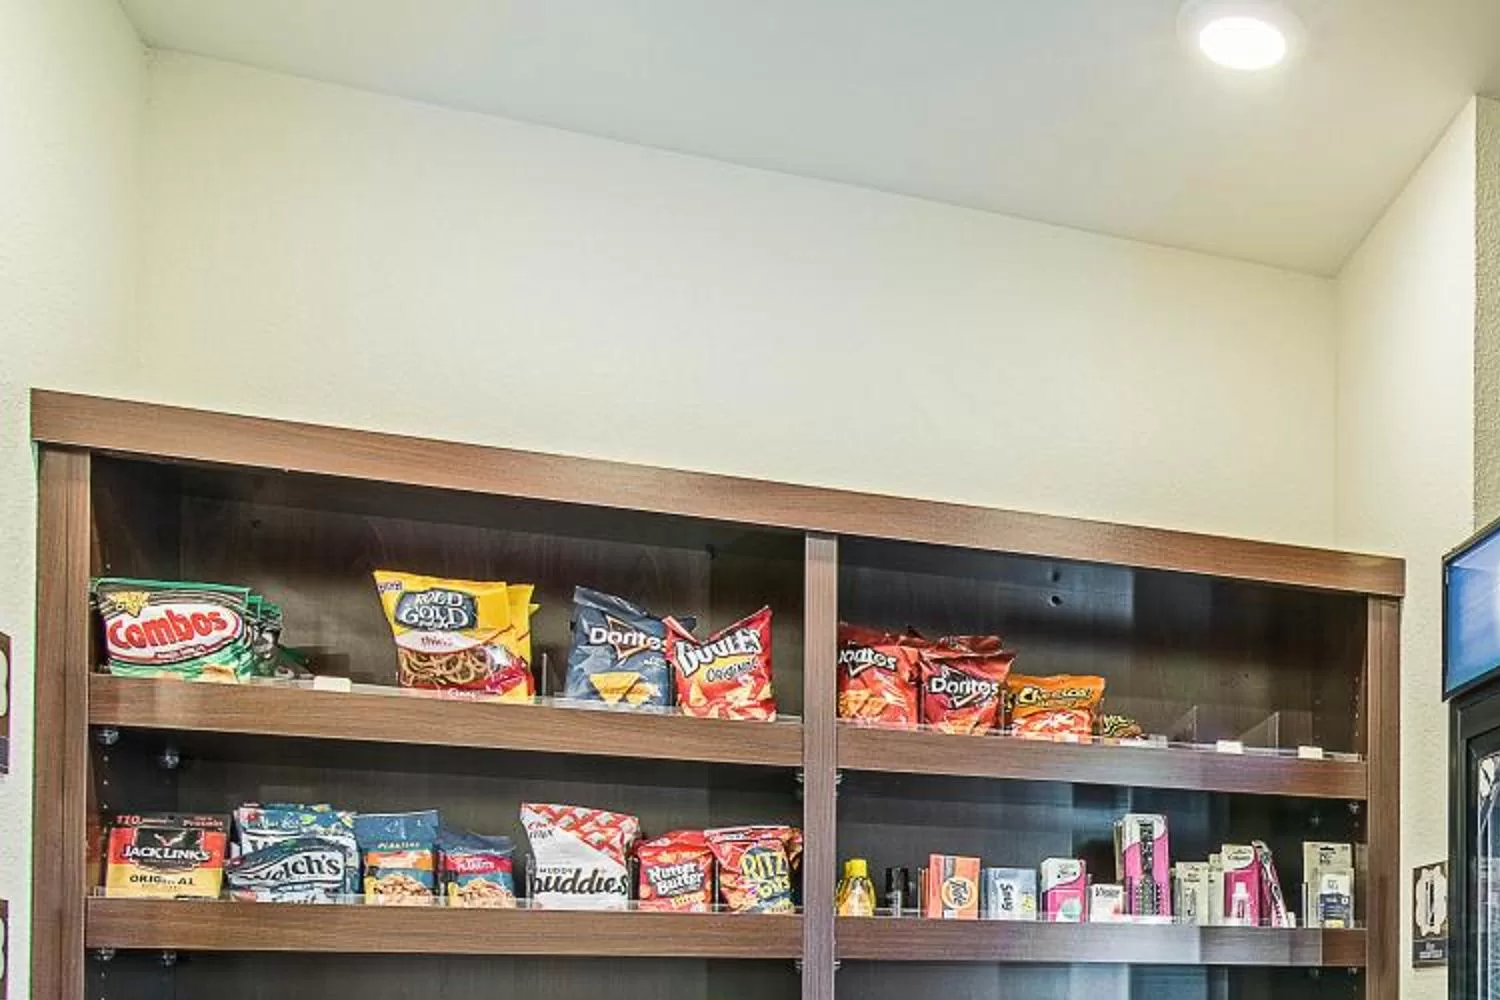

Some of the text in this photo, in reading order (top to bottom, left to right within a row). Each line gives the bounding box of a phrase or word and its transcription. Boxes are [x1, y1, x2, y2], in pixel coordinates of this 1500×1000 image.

[415, 590, 464, 607] ROLD
[400, 604, 469, 627] GOLD
[107, 607, 229, 651] Combos
[838, 646, 897, 672] oritos
[931, 676, 999, 700] Doritos
[122, 844, 162, 859] JACK
[647, 861, 698, 883] Nutter
[741, 852, 789, 880] RITZ
[129, 873, 197, 886] ORIGAL
[656, 872, 705, 895] Butter
